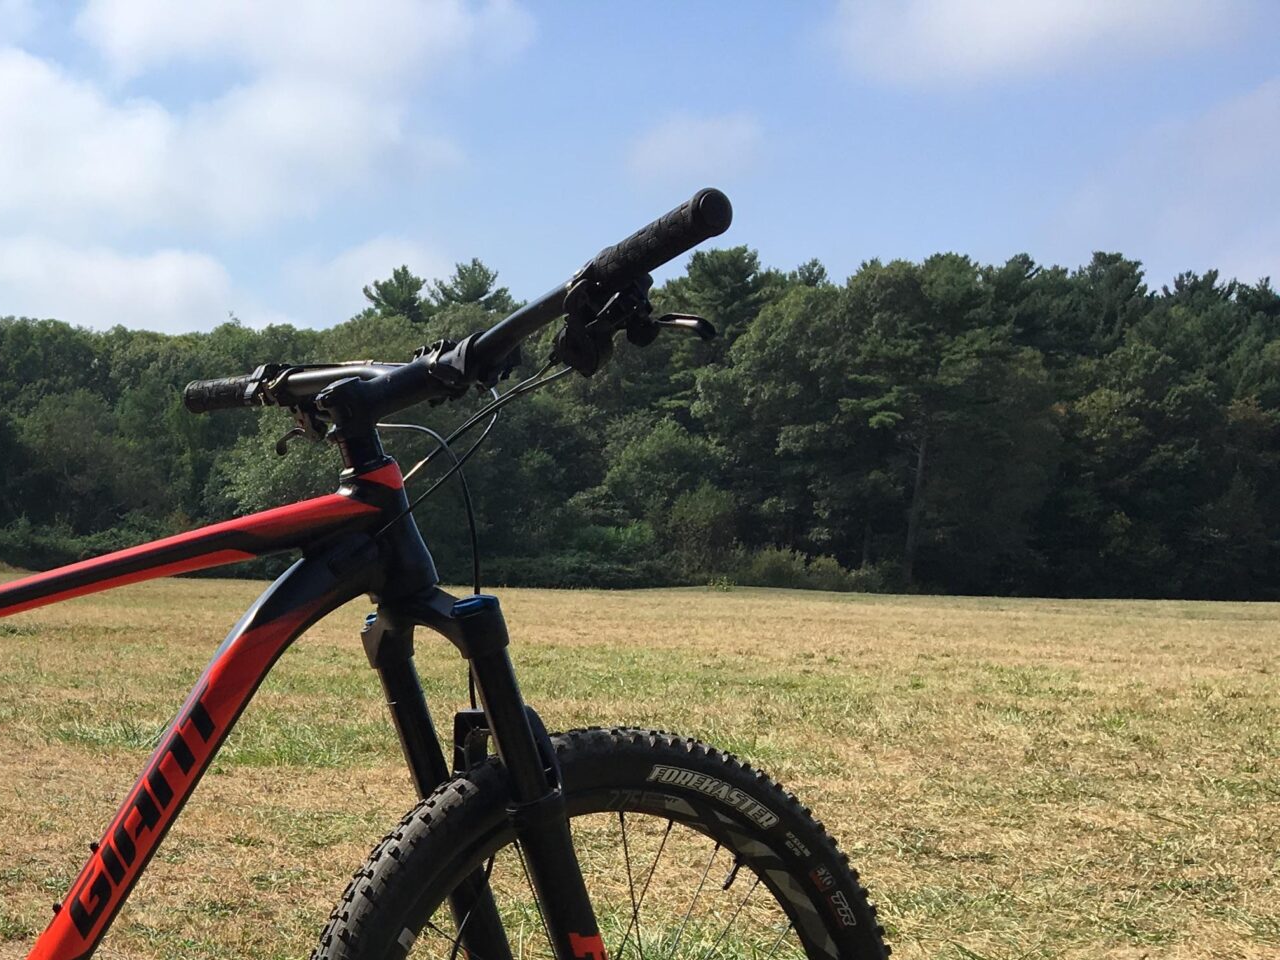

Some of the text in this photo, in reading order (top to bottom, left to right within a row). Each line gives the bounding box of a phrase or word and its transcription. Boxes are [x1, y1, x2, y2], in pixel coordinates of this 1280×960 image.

[70, 682, 216, 940] GIANT
[646, 764, 779, 829] FOREKASTER
[831, 891, 856, 926] TR
